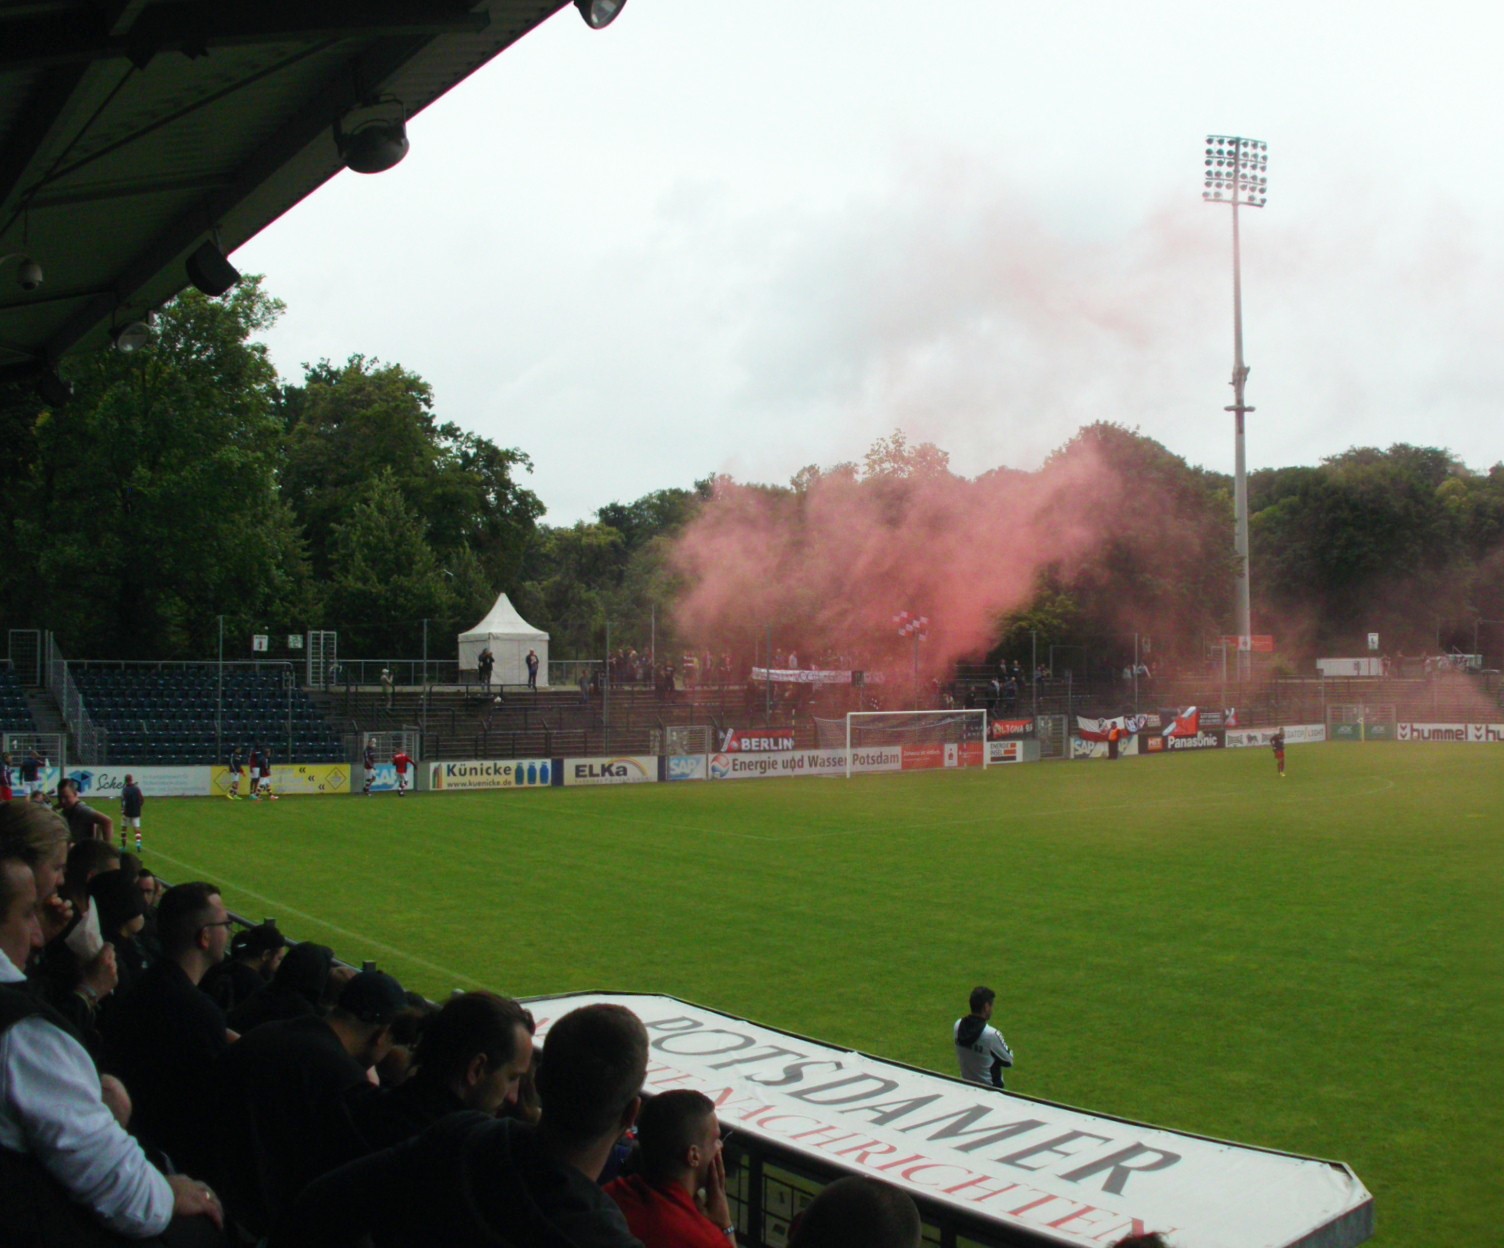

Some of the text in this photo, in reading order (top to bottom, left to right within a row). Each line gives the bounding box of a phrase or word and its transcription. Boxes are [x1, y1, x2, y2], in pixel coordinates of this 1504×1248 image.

[1410, 724, 1468, 741] hummel
[741, 737, 793, 751] BERLIN
[1167, 734, 1218, 749] Panasonic
[446, 761, 512, 778] Künicke
[575, 763, 628, 779] ELKa
[670, 758, 697, 775] SAP
[732, 756, 778, 774] Energie
[782, 755, 804, 771] und
[852, 751, 900, 767] Potsdam
[646, 1015, 1183, 1197] POTSDAMER
